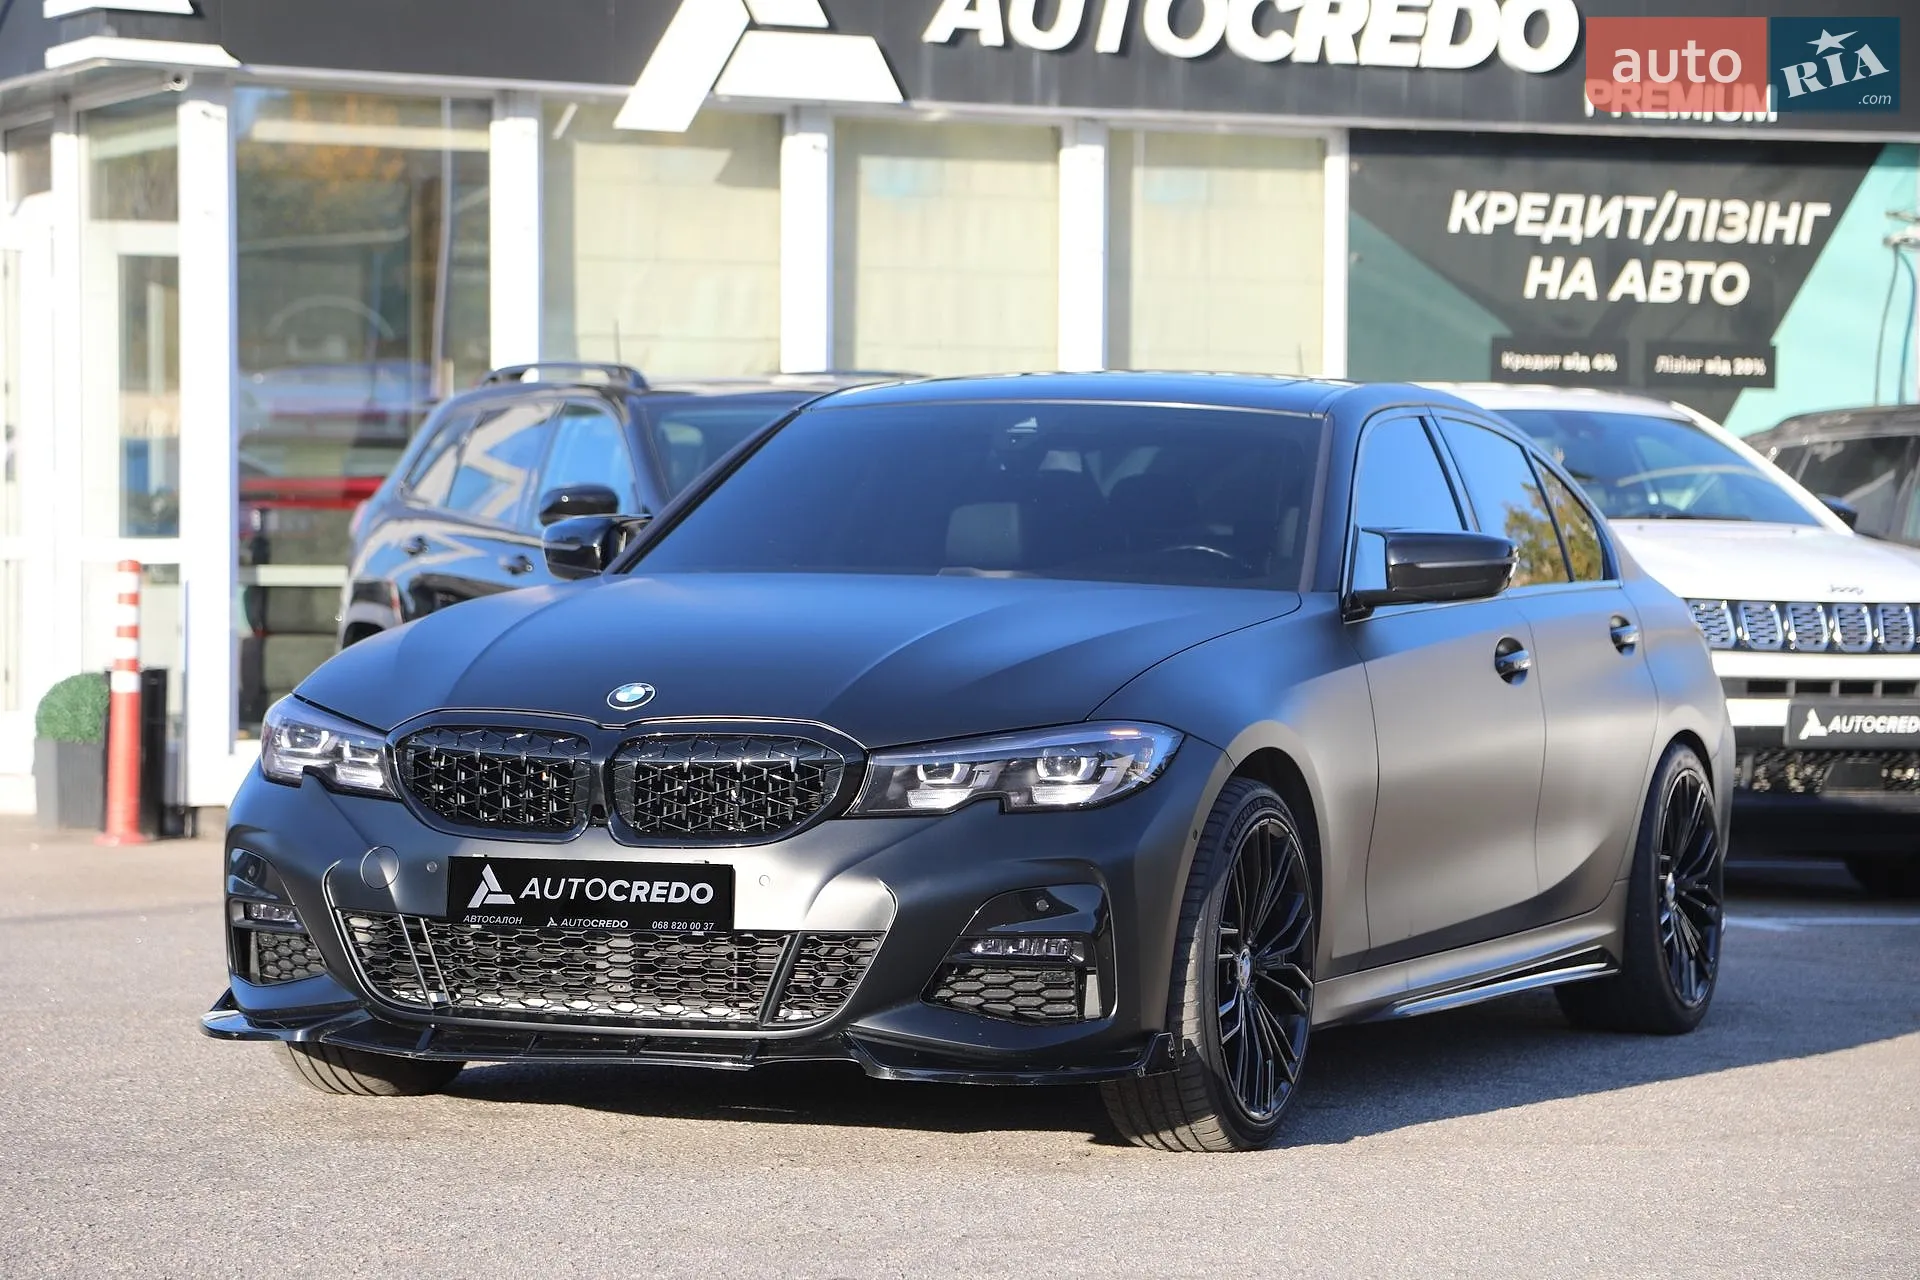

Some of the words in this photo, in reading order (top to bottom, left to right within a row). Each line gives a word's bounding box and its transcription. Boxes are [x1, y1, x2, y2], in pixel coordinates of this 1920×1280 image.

[1584, 79, 1778, 123] PREMIUM
[1447, 190, 1832, 245] КРЕДИТ/ЛІЗІНГ
[1523, 256, 1599, 301] НА
[1607, 258, 1751, 305] АВТО
[1827, 715, 1920, 734] AUTOCRED
[519, 877, 714, 905] AUTOCREDO
[462, 914, 523, 925] АВТОСАЛОН
[560, 918, 629, 930] AUTOCREDO
[651, 920, 669, 930] 068
[671, 921, 688, 931] 820
[689, 922, 701, 931] 00
[703, 922, 715, 932] 37
